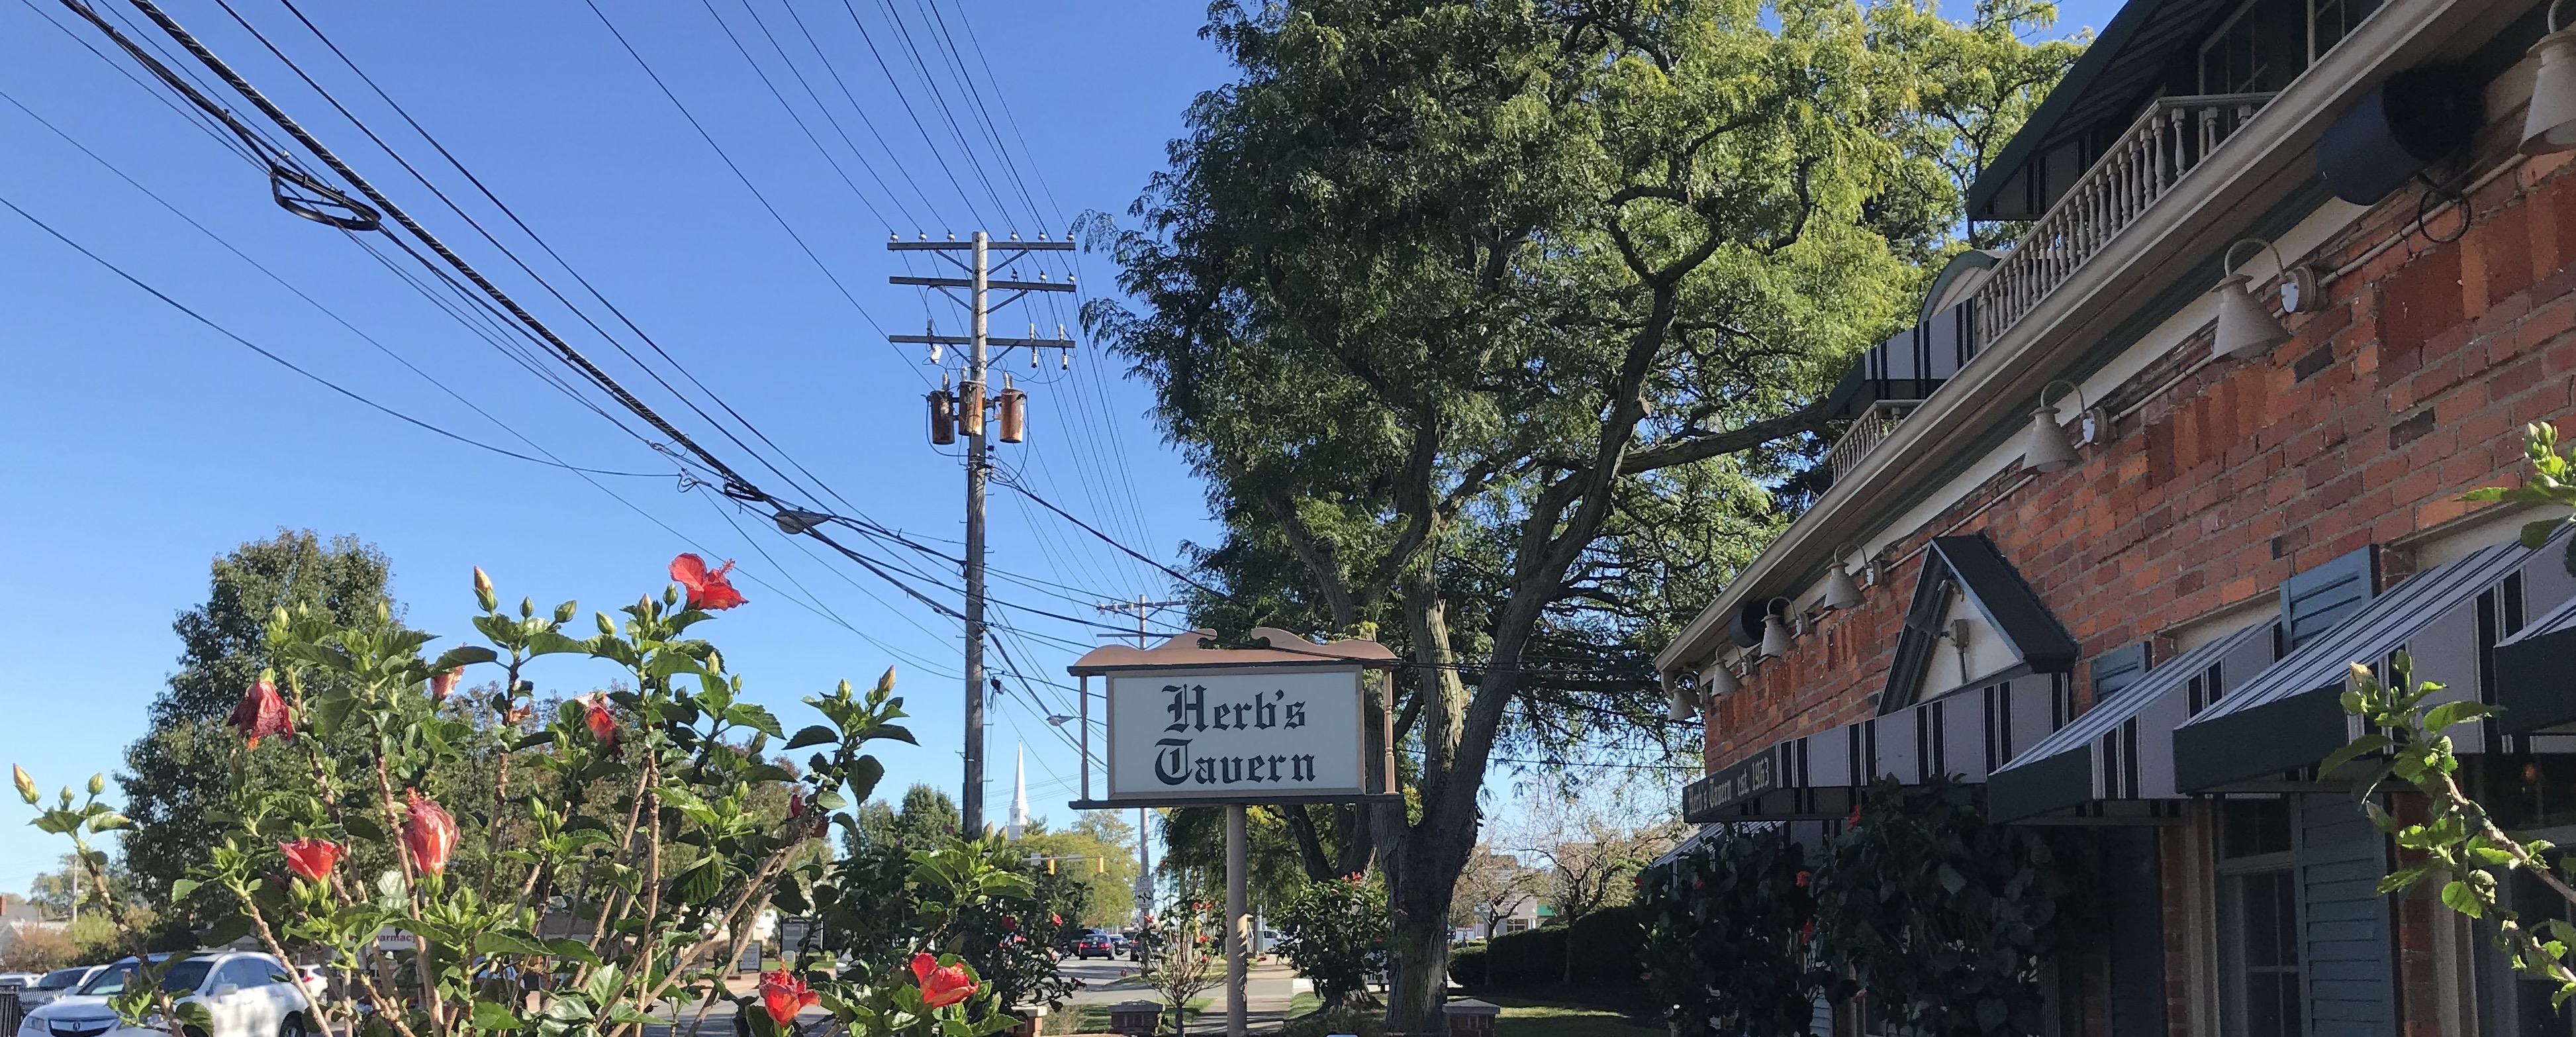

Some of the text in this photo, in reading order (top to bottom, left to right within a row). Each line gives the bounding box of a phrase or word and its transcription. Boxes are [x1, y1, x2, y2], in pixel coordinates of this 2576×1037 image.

[1162, 683, 1306, 733] Herb's
[1154, 738, 1316, 786] Tavern
[1688, 783, 1707, 816] Herb's
[1709, 777, 1732, 809] Tavern
[1752, 756, 1770, 791] 1963
[377, 934, 416, 943] armacy
